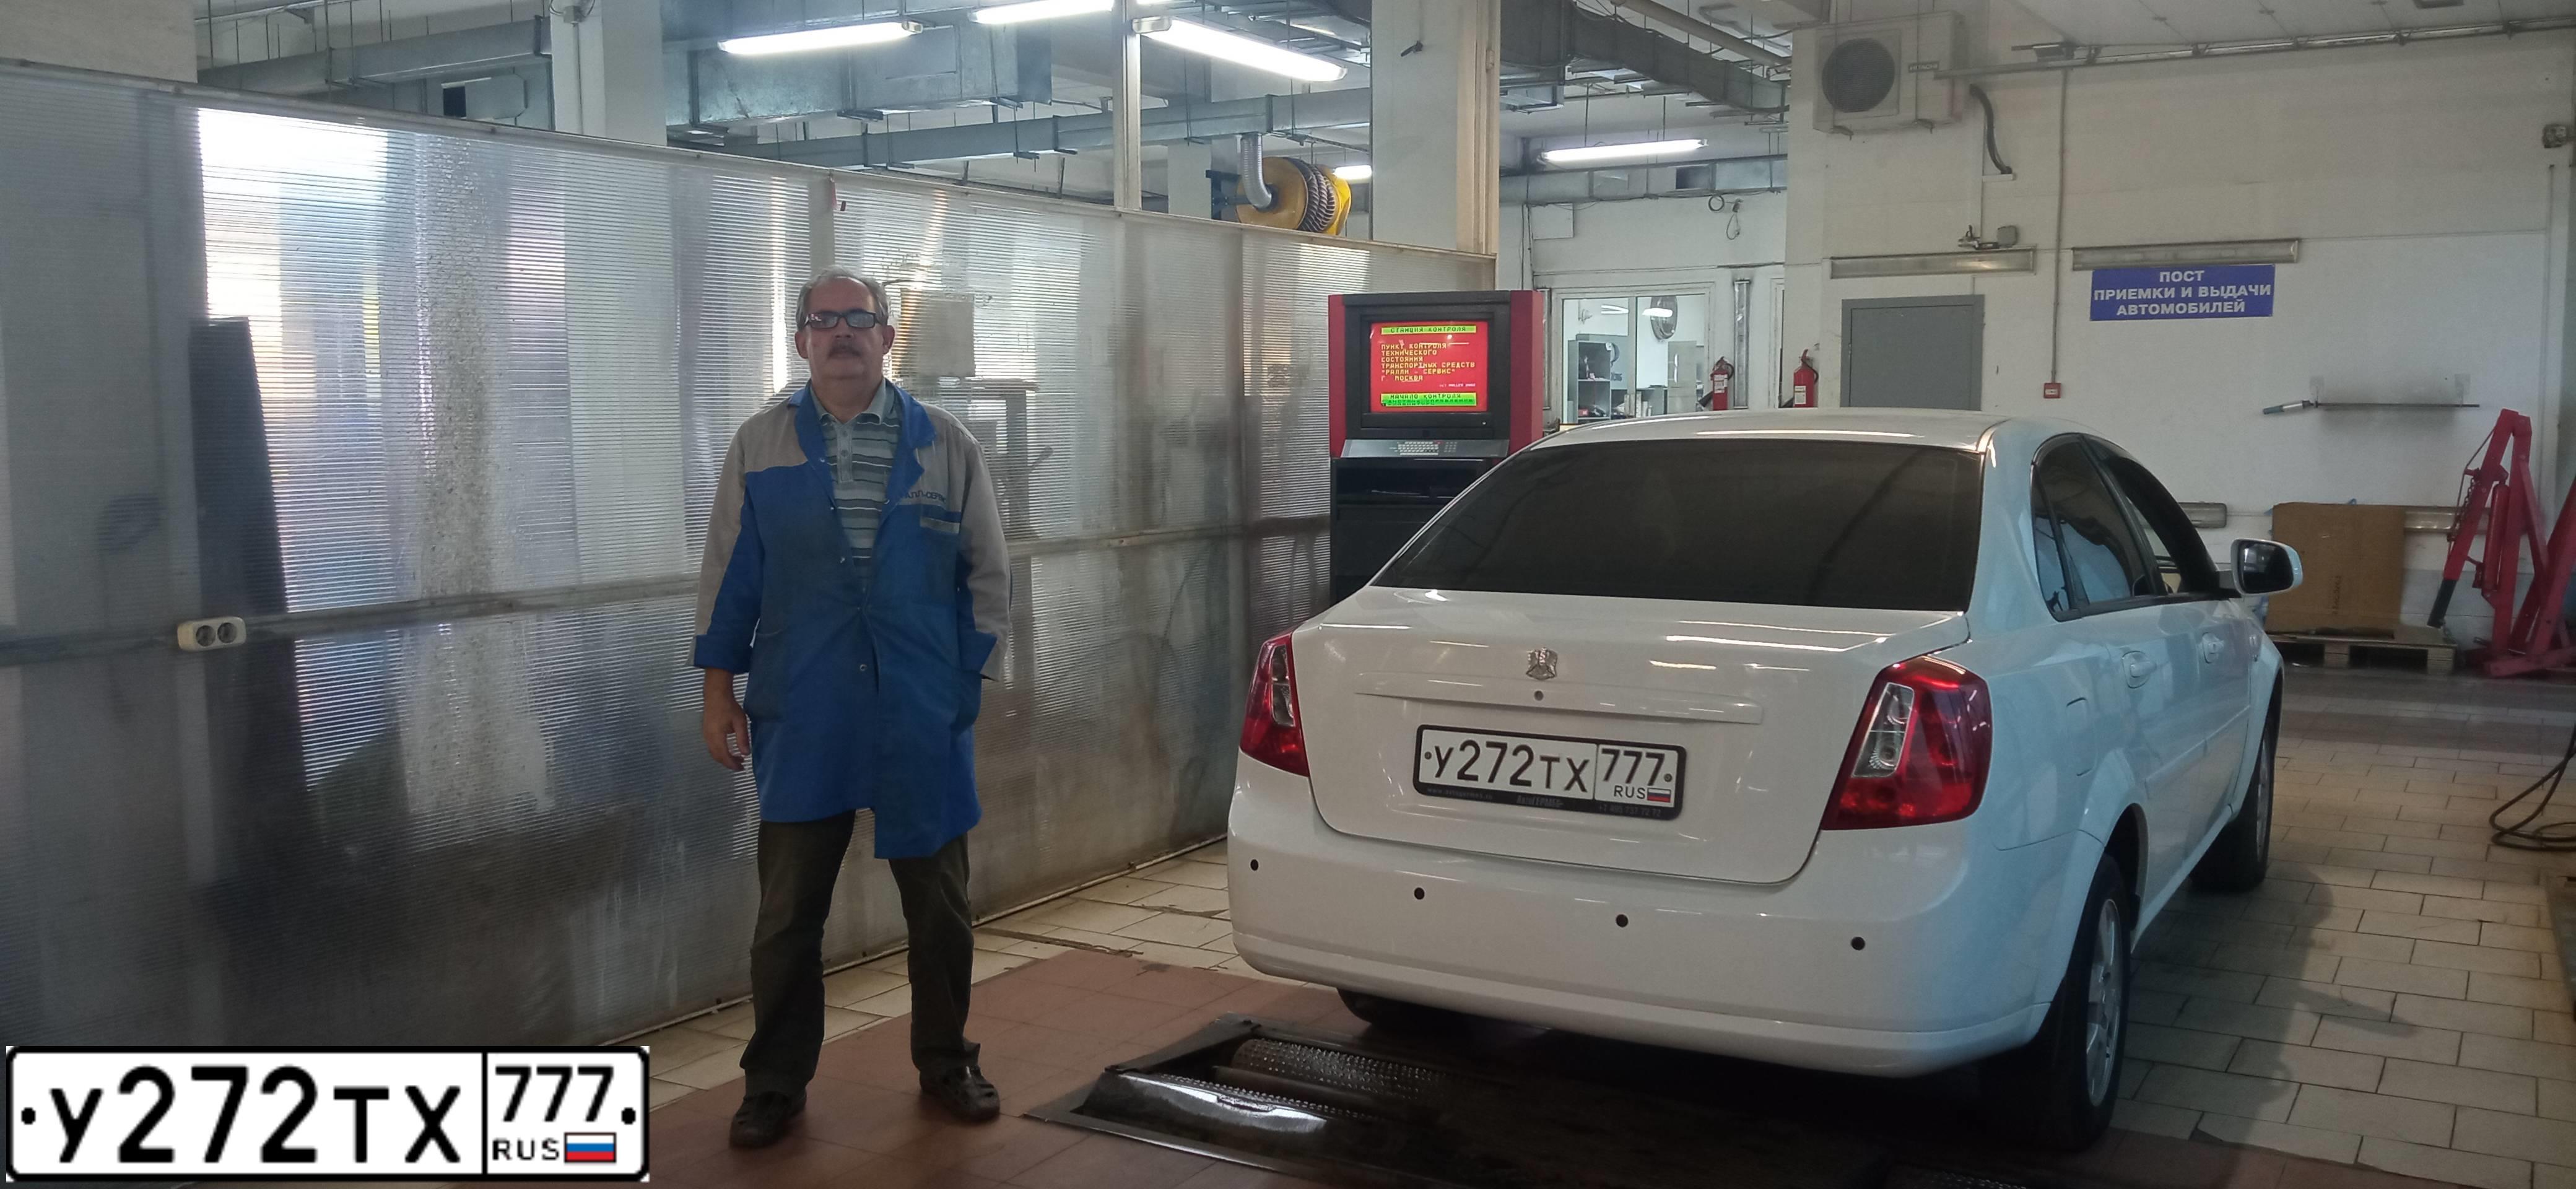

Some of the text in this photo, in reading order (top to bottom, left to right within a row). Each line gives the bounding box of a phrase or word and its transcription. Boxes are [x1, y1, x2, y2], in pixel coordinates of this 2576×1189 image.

[2159, 270, 2204, 282] ПОСТ
[2094, 284, 2271, 300] ПРИЕМКИ И ВЫДАЧИ
[2117, 299, 2245, 316] АВТОМОБИЛЕЙ
[1435, 740, 1590, 792] У272ТХ
[1601, 748, 1665, 786] 777
[1614, 785, 1645, 799] RUS
